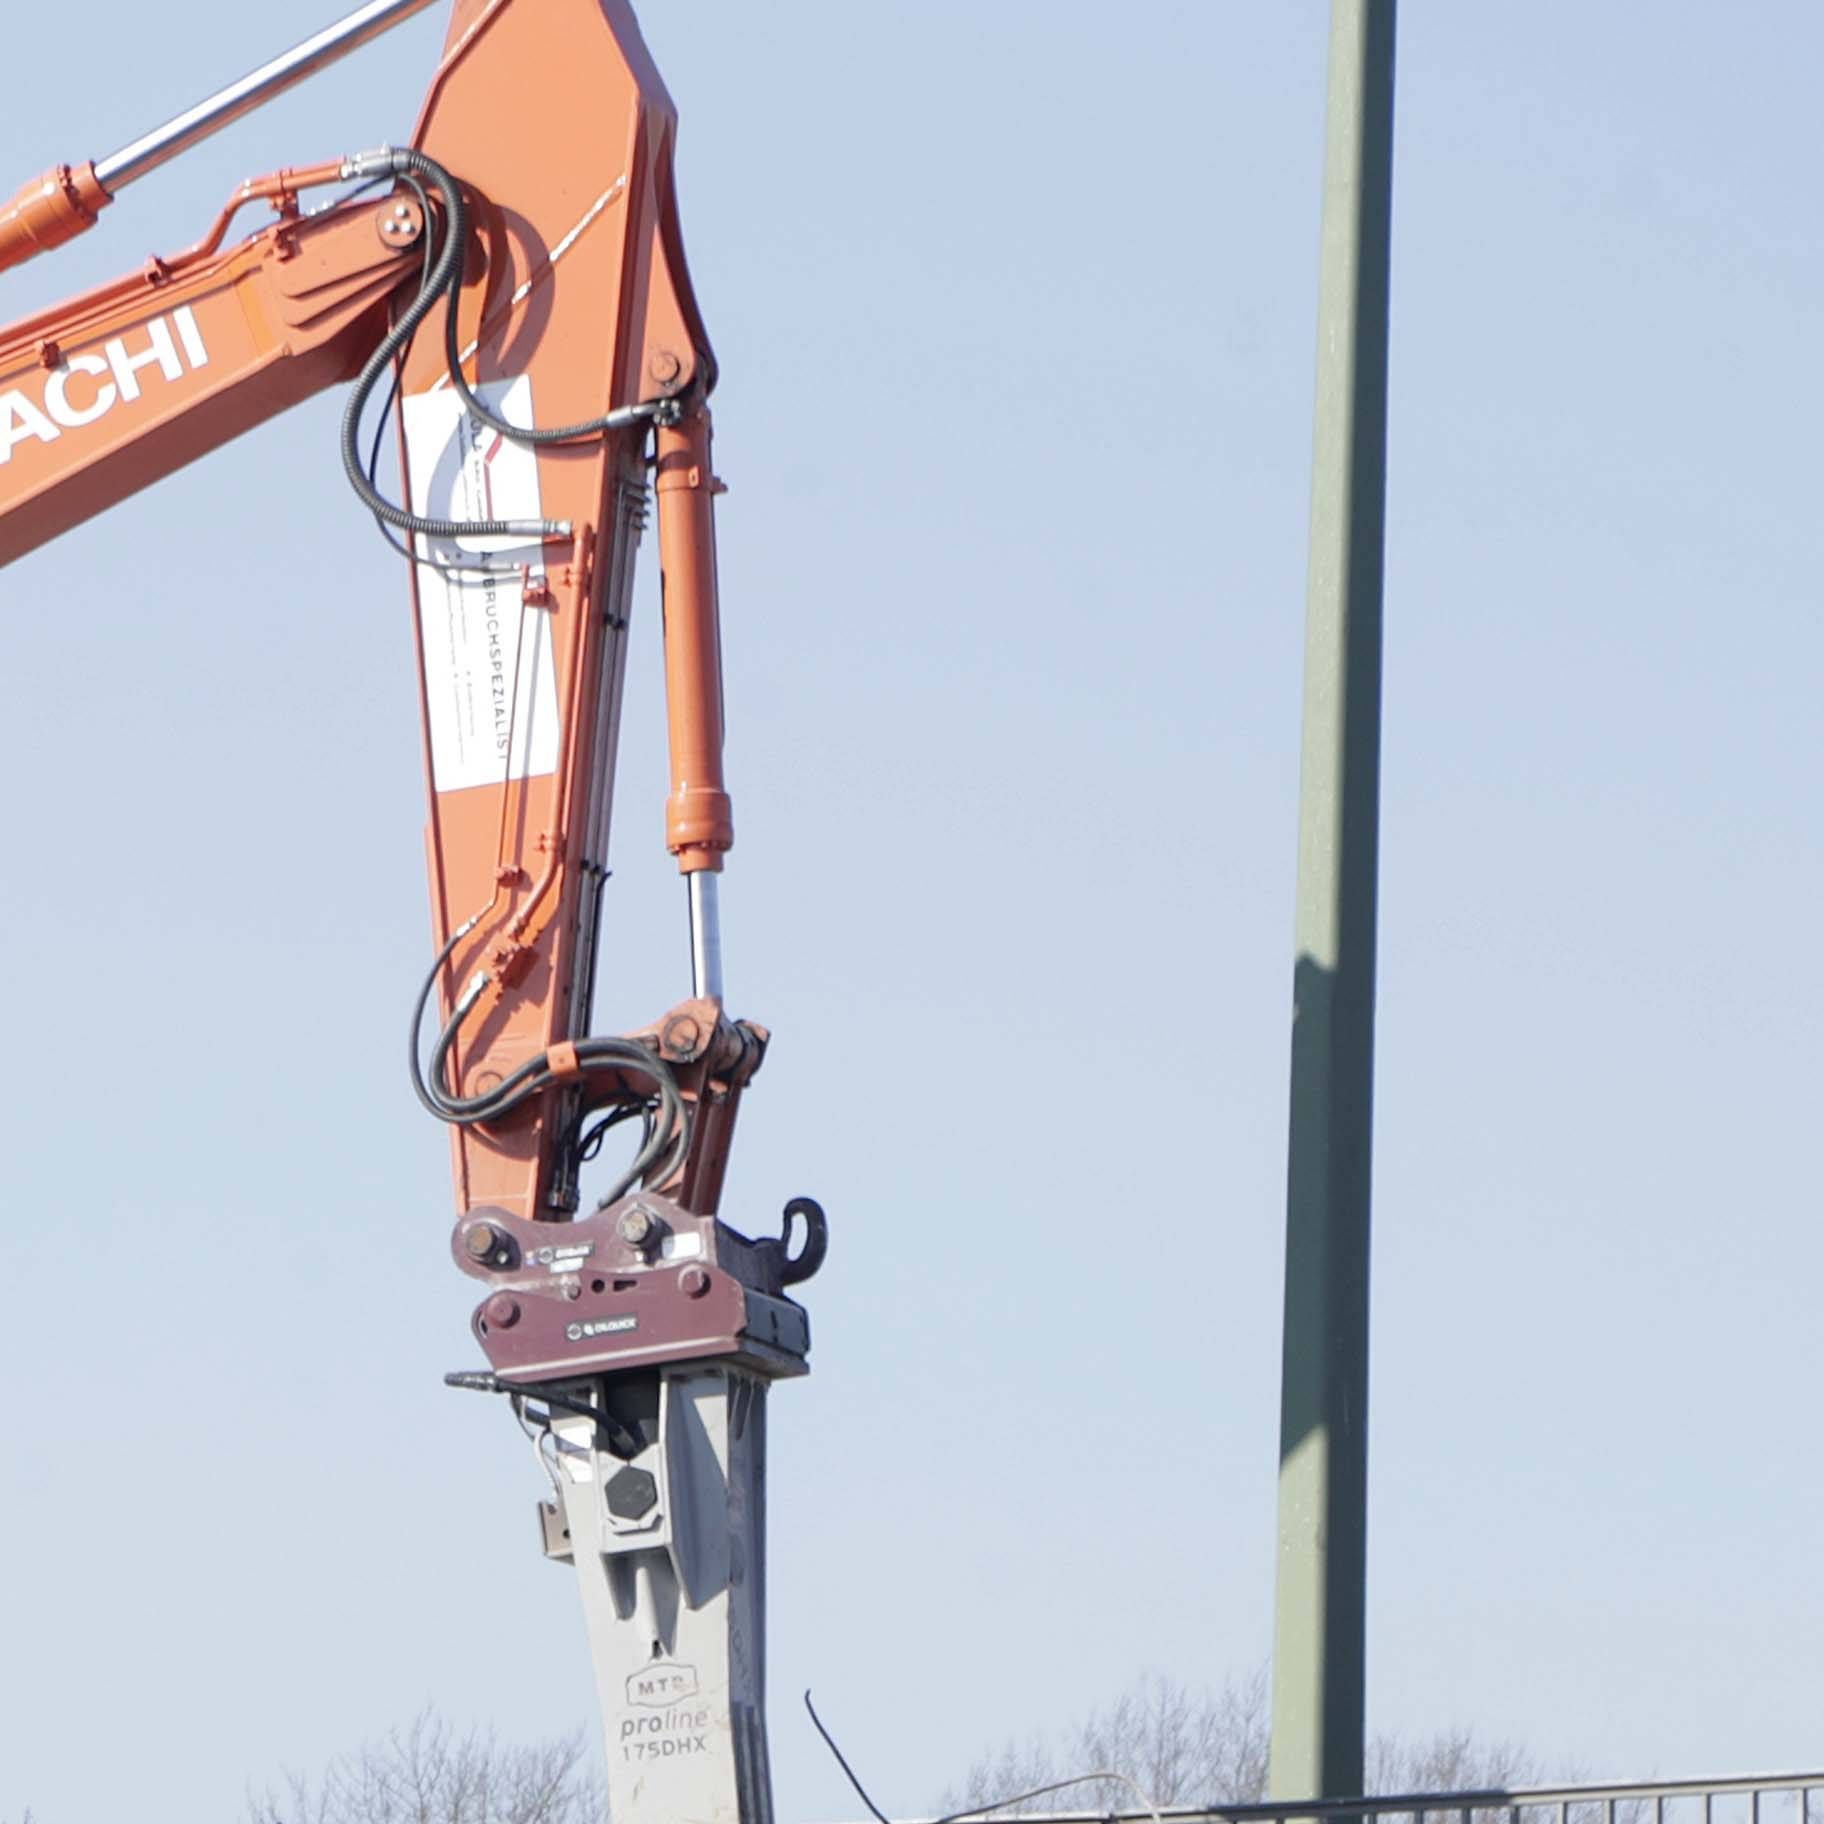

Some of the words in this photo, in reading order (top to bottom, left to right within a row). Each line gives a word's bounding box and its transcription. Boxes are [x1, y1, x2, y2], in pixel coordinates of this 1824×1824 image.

[481, 551, 508, 759] ABRUCHSPEZIALIST
[620, 1709, 708, 1741] proline
[623, 1736, 707, 1761] 175DHX
